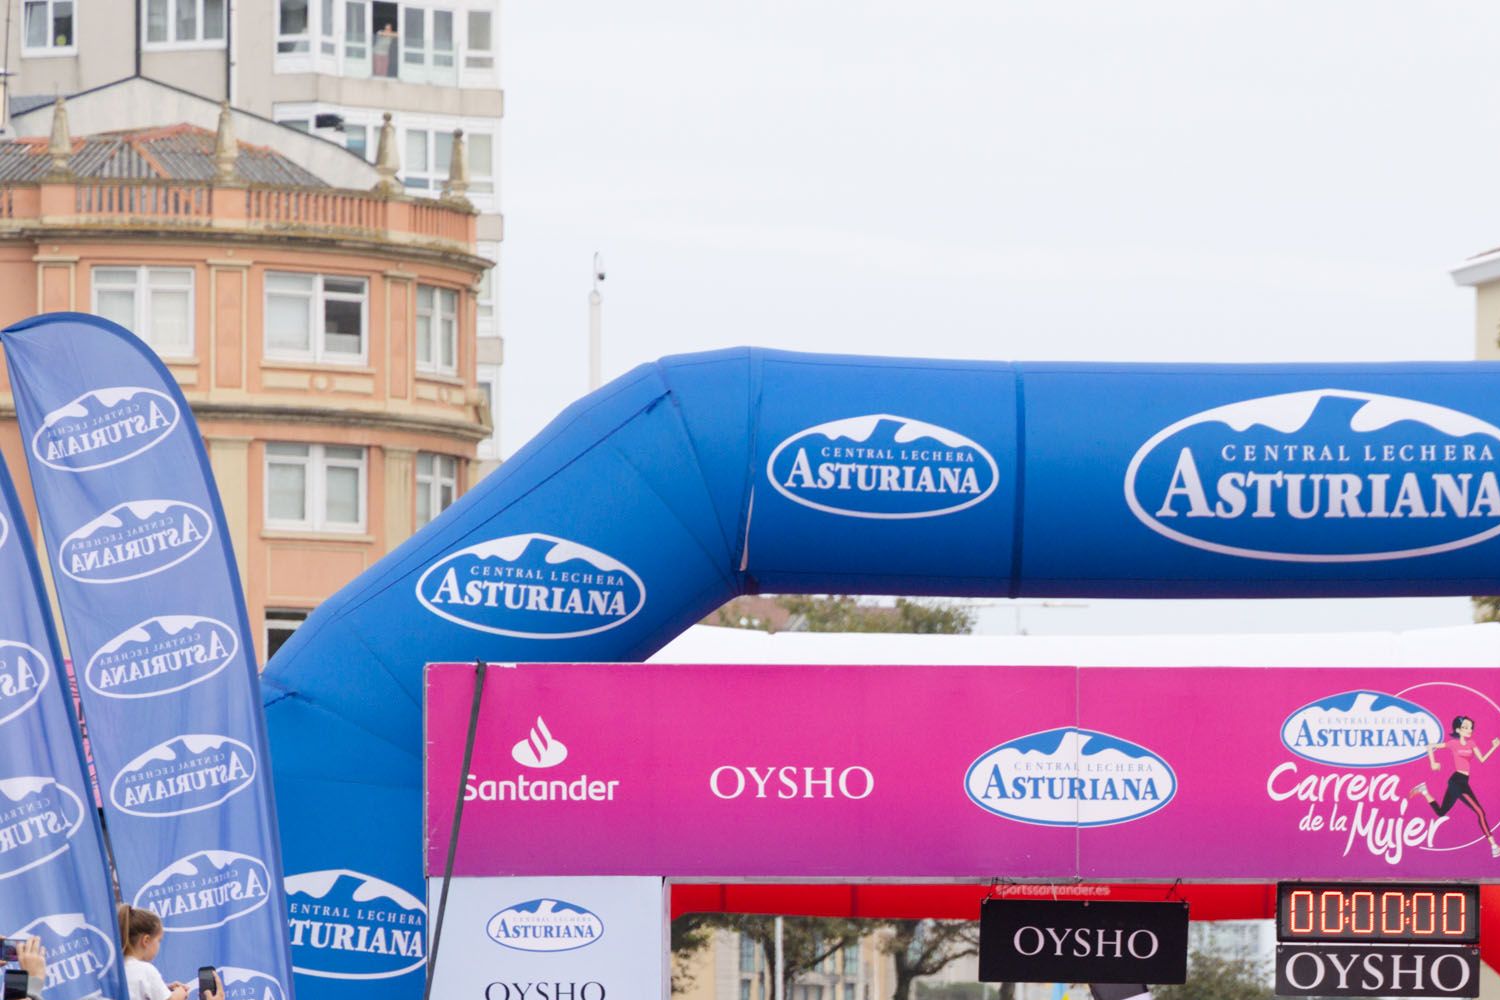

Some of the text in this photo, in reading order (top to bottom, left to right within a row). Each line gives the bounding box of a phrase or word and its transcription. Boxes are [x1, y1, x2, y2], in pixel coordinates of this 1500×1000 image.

[822, 446, 975, 462] CENTRAL LECHERA
[1221, 444, 1495, 462] CENTRAL LECHERA
[784, 447, 981, 494] ASTURIANA
[431, 567, 627, 616] ASTURIANA
[471, 565, 625, 586] CENTRAL LECHERA
[1294, 719, 1430, 747] ASTURIANA
[709, 766, 875, 800] OYSHO
[982, 764, 1159, 801] ASTURIANA
[1014, 762, 1153, 773] CENTRAL LECHERA
[1266, 762, 1400, 802] Carrera
[463, 775, 619, 801] Santander
[1299, 798, 1449, 865] de la Mujer
[289, 902, 423, 926] ENTRAL LECHERA
[1290, 890, 1466, 934] 00:00:00
[289, 918, 423, 958] TURIANA
[495, 918, 595, 940] ASTURIANA
[1013, 926, 1159, 959] OYSHO
[1285, 952, 1470, 992] OYSHO
